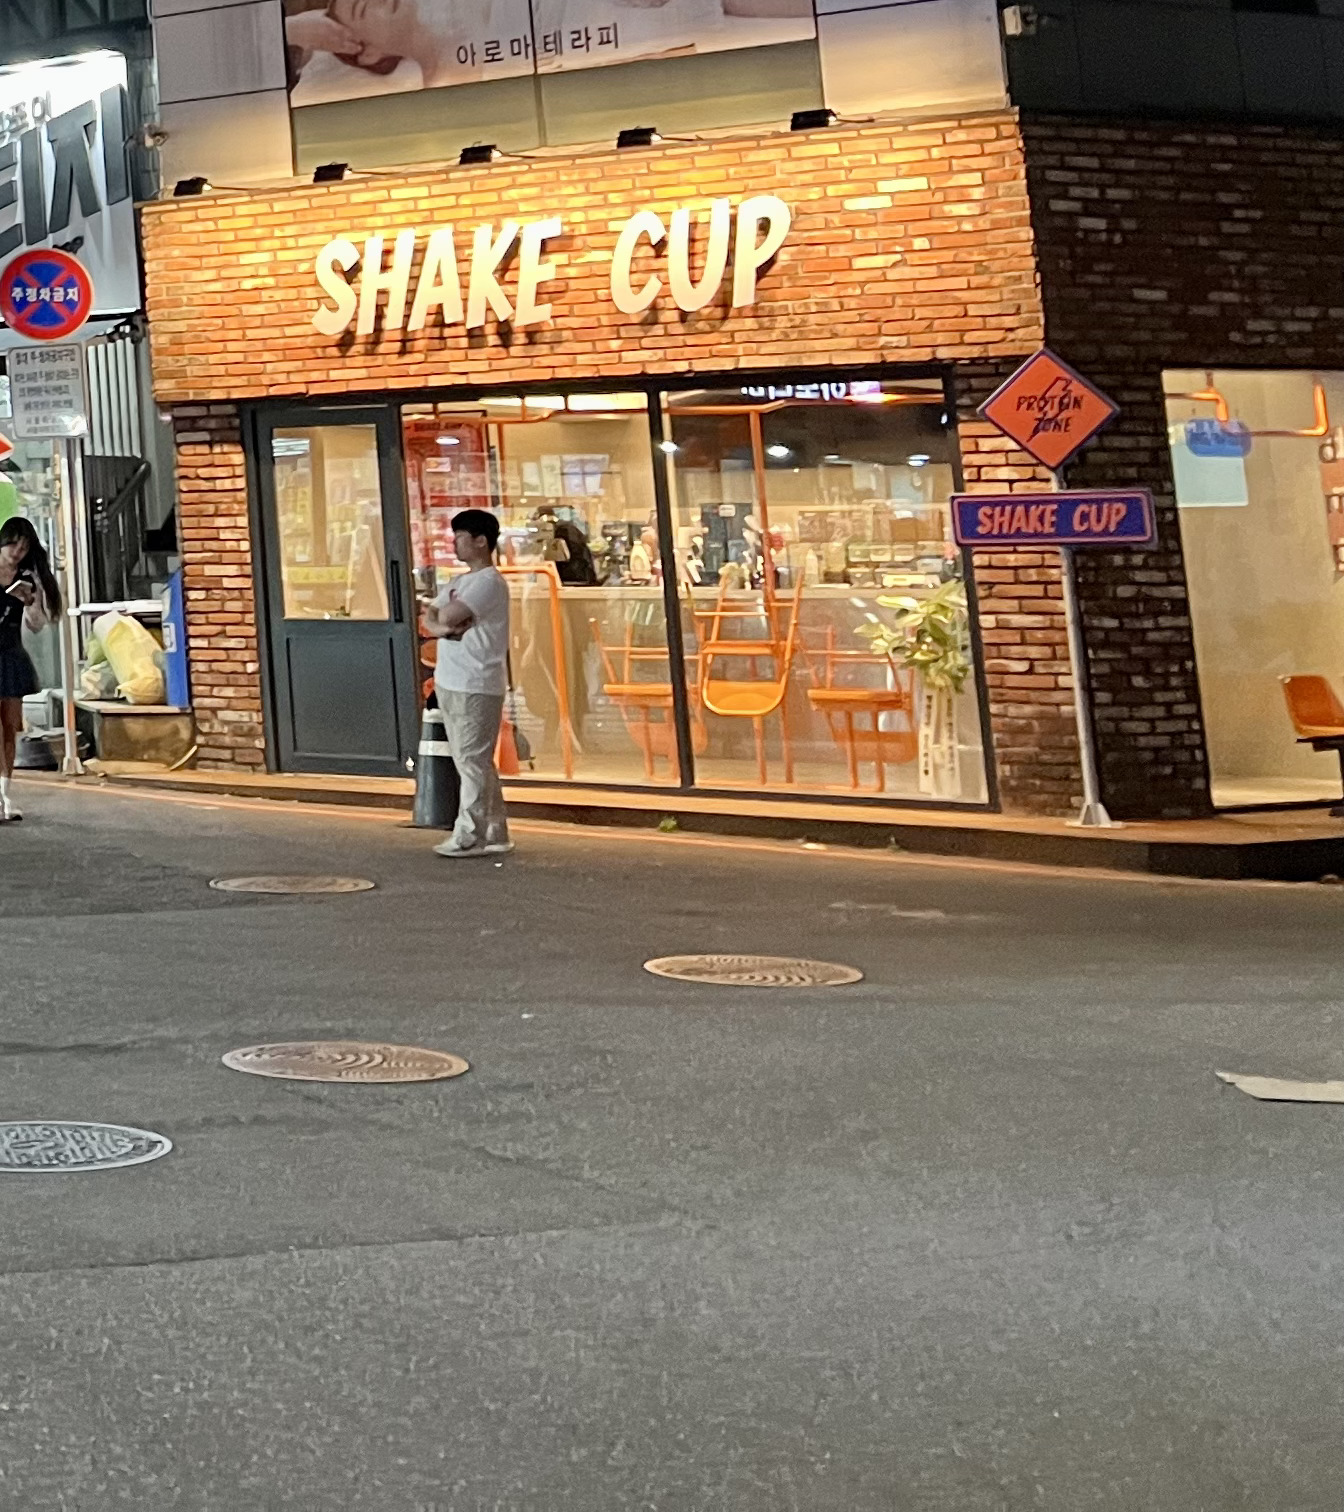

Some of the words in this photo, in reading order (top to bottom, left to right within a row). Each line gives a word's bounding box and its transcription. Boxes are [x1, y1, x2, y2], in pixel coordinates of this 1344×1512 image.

[455, 21, 621, 68] 아로마테라피
[312, 216, 563, 338] SHAKE
[609, 194, 793, 317] CUP
[10, 286, 79, 303] 주정차금지
[977, 503, 1058, 536] SHAKE
[1071, 500, 1128, 534] CUP
